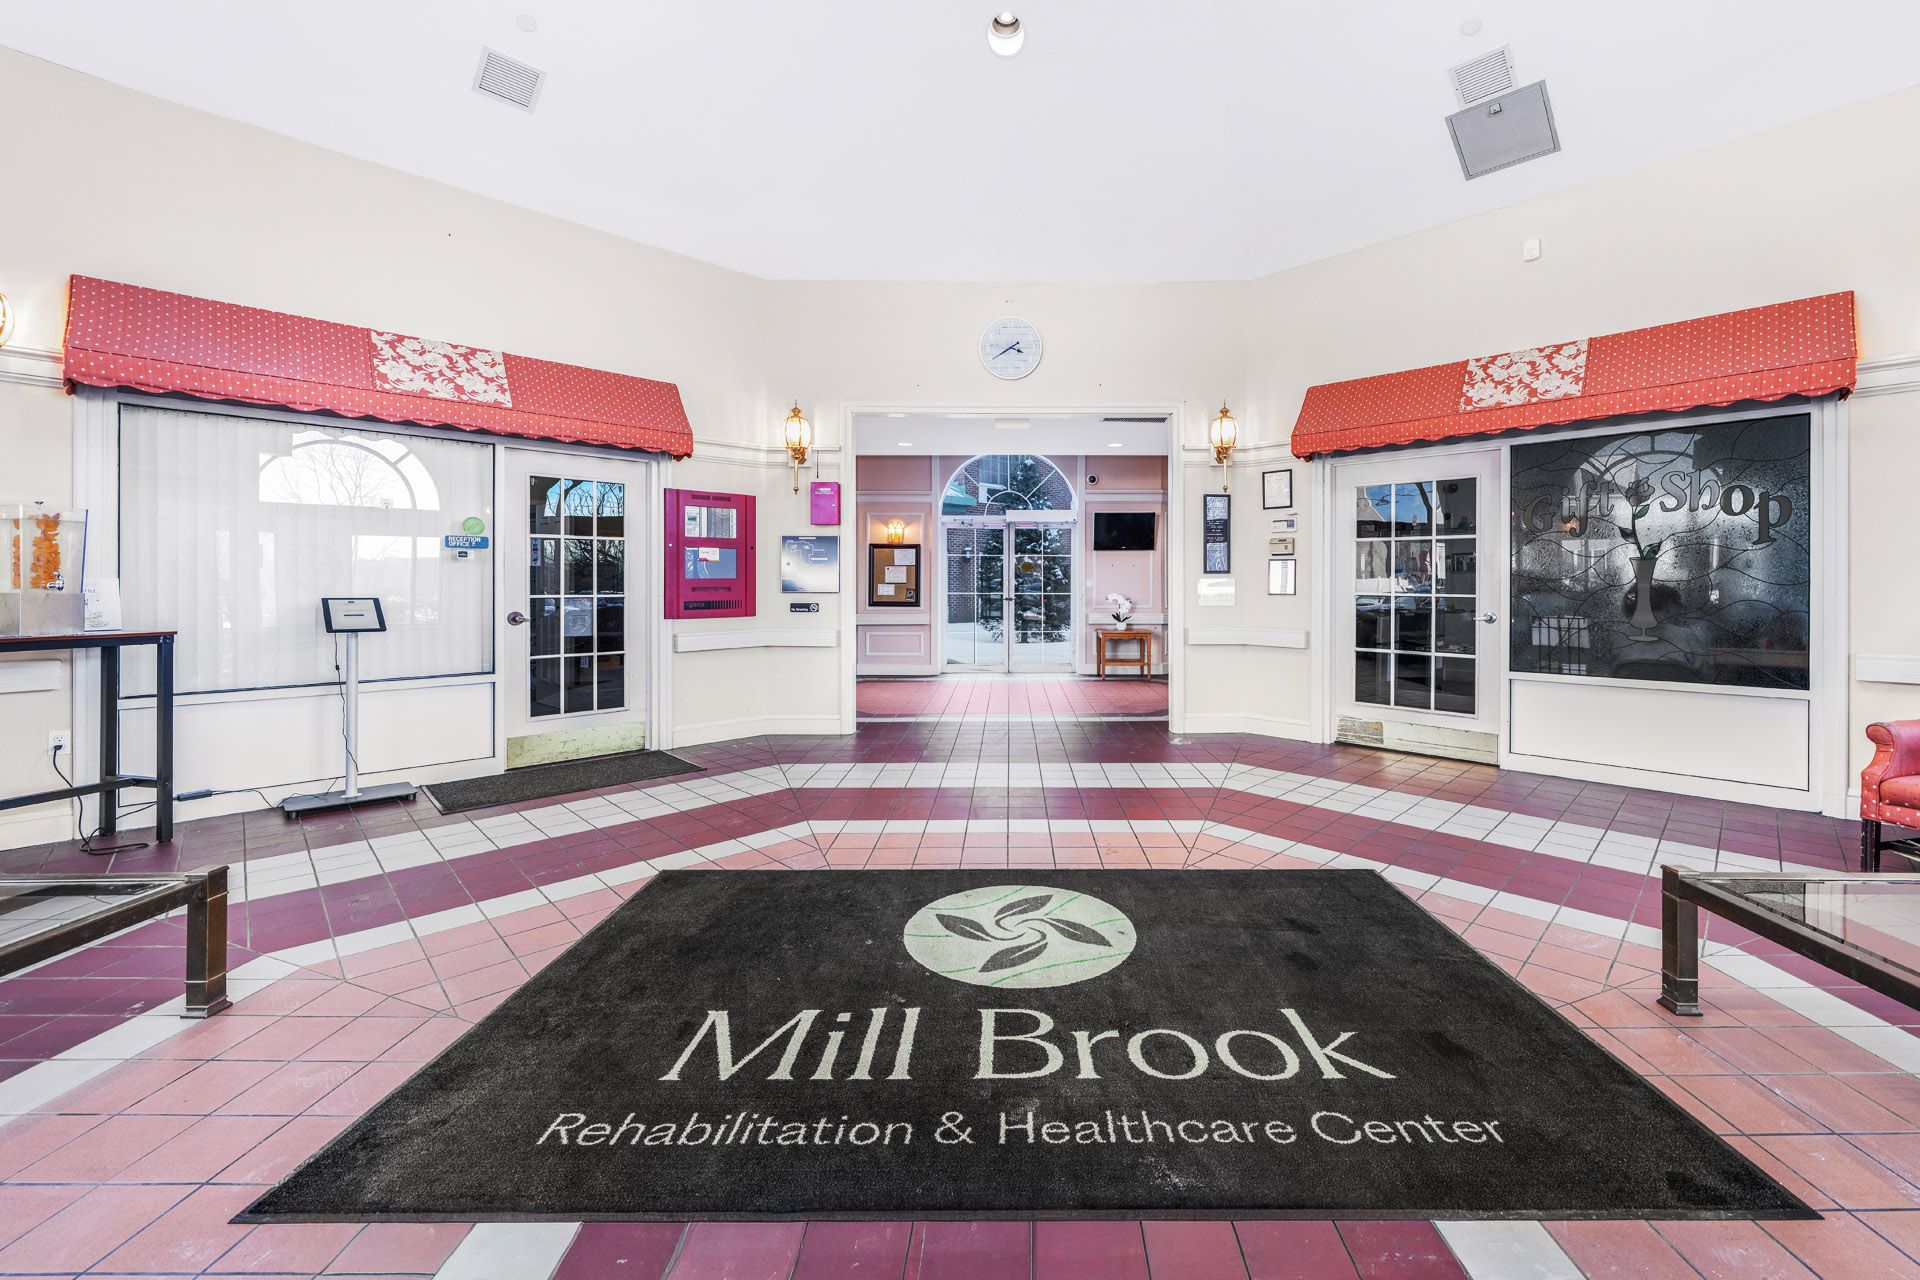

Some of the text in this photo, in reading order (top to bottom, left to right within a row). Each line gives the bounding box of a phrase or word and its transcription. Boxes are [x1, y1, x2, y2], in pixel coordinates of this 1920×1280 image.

[1523, 470, 1792, 545] Gift Shop
[658, 1006, 1397, 1081] Mill Brook
[536, 1110, 1504, 1147] Rehabilitation & Healthcare Center
